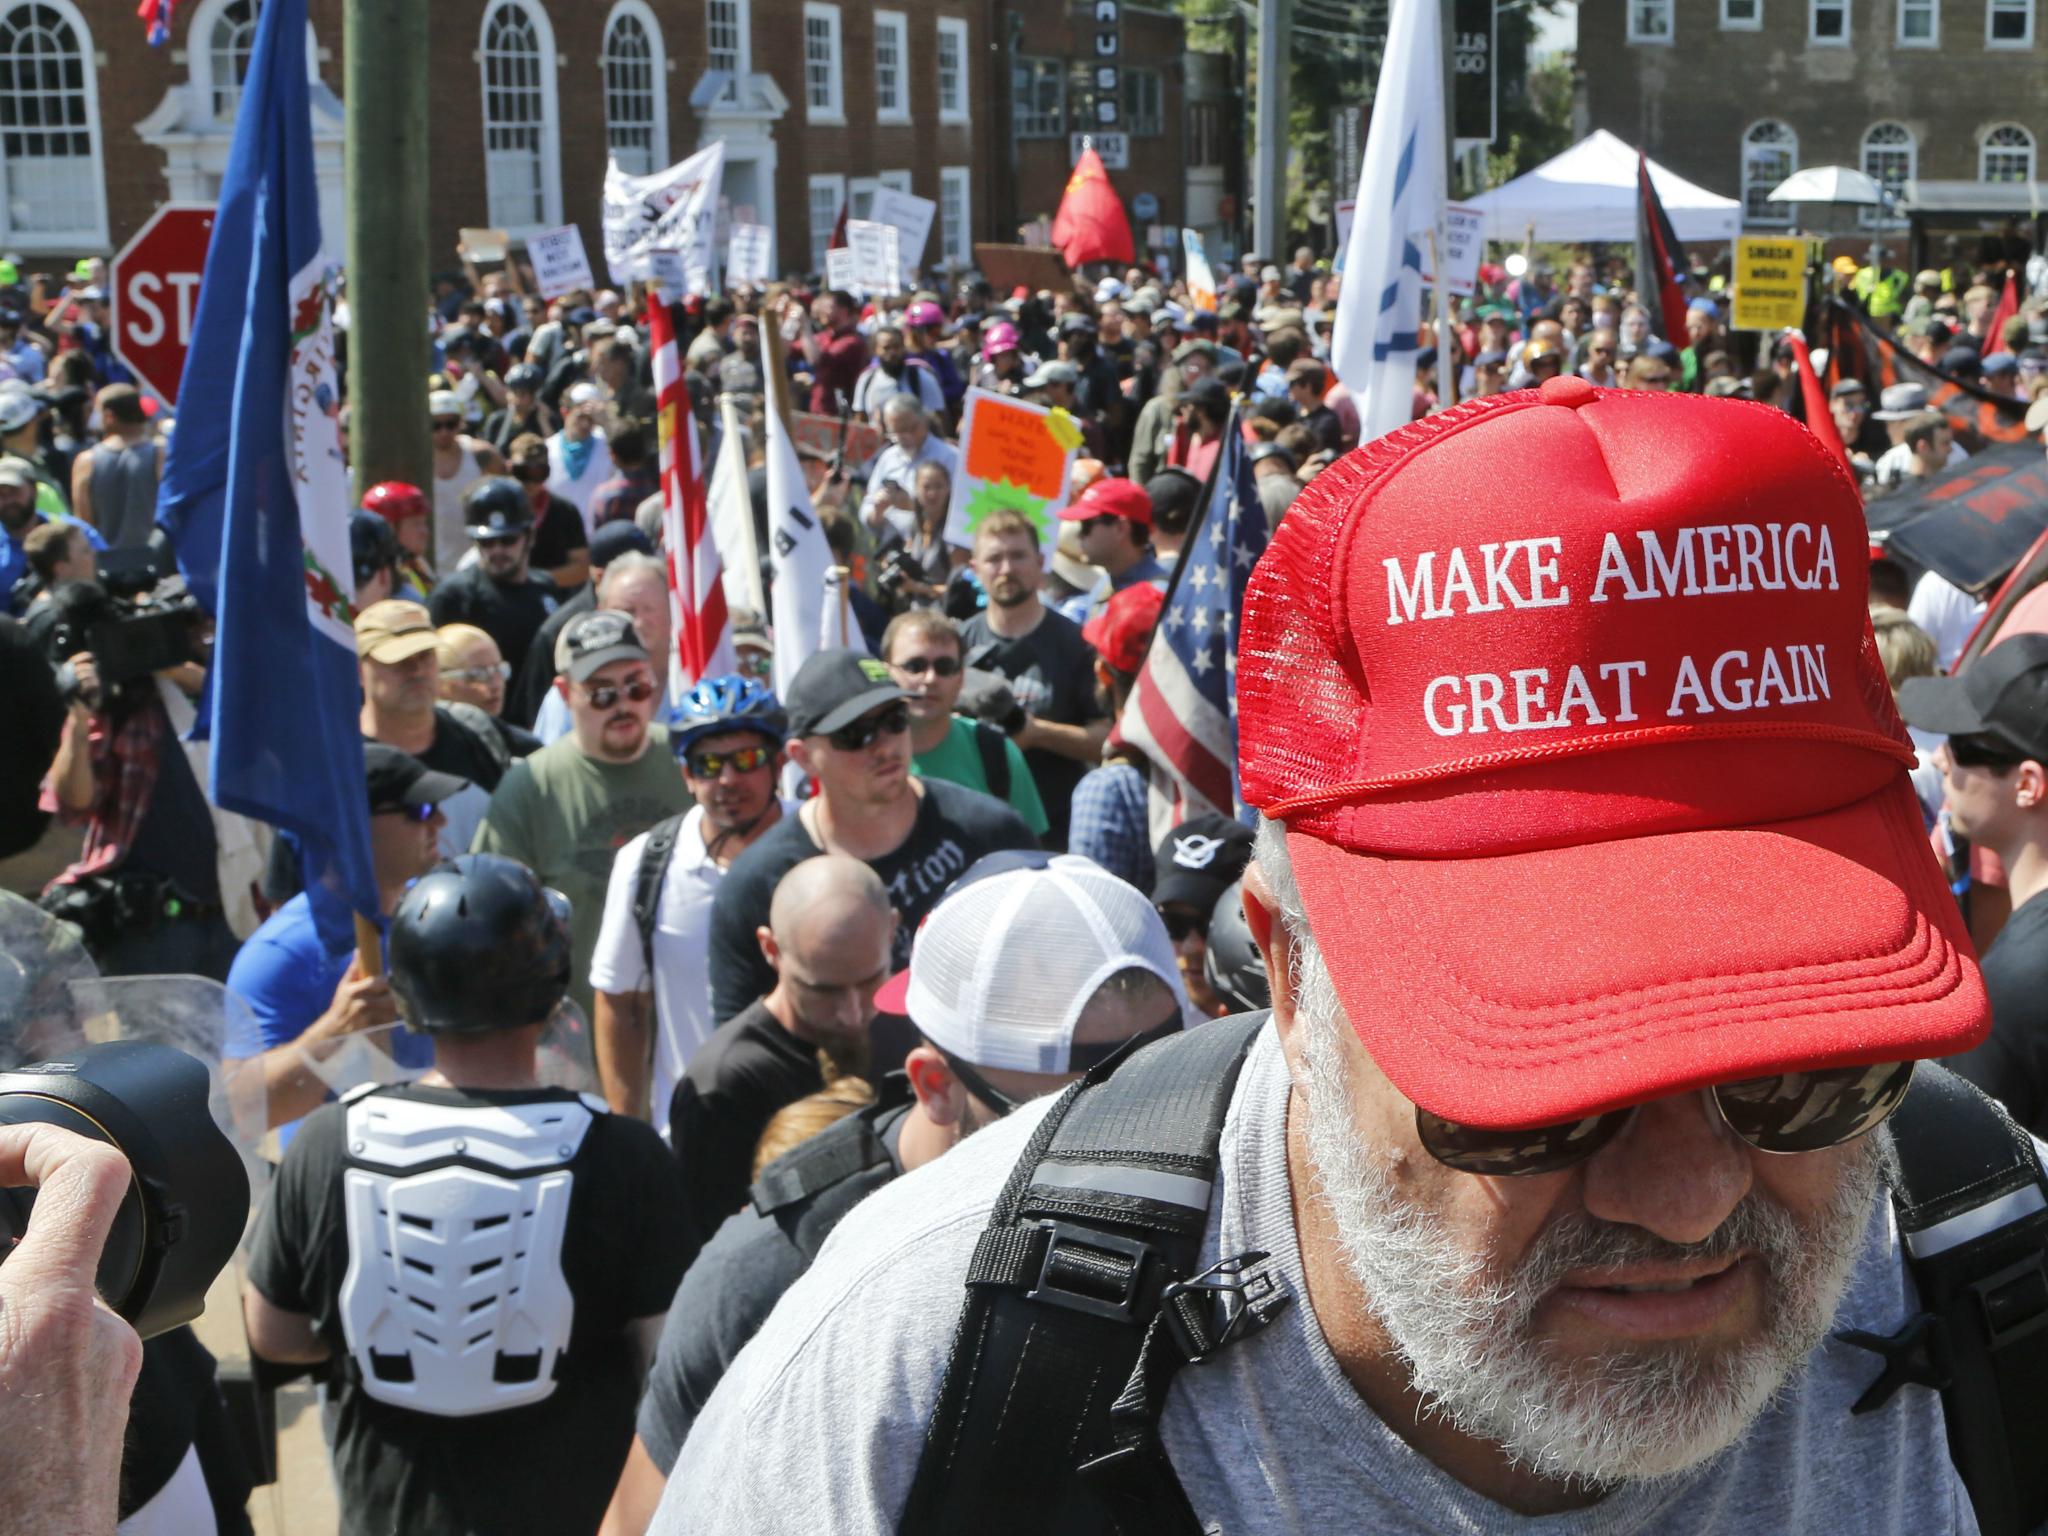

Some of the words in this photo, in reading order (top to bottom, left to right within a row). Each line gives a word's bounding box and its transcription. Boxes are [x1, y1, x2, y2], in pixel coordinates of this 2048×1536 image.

[127, 271, 202, 347] ST
[1381, 535, 1570, 626] MAKE
[1589, 522, 1840, 603] AMERICA
[1422, 660, 1647, 737] GREAT
[1666, 643, 1831, 717] AGAIN
